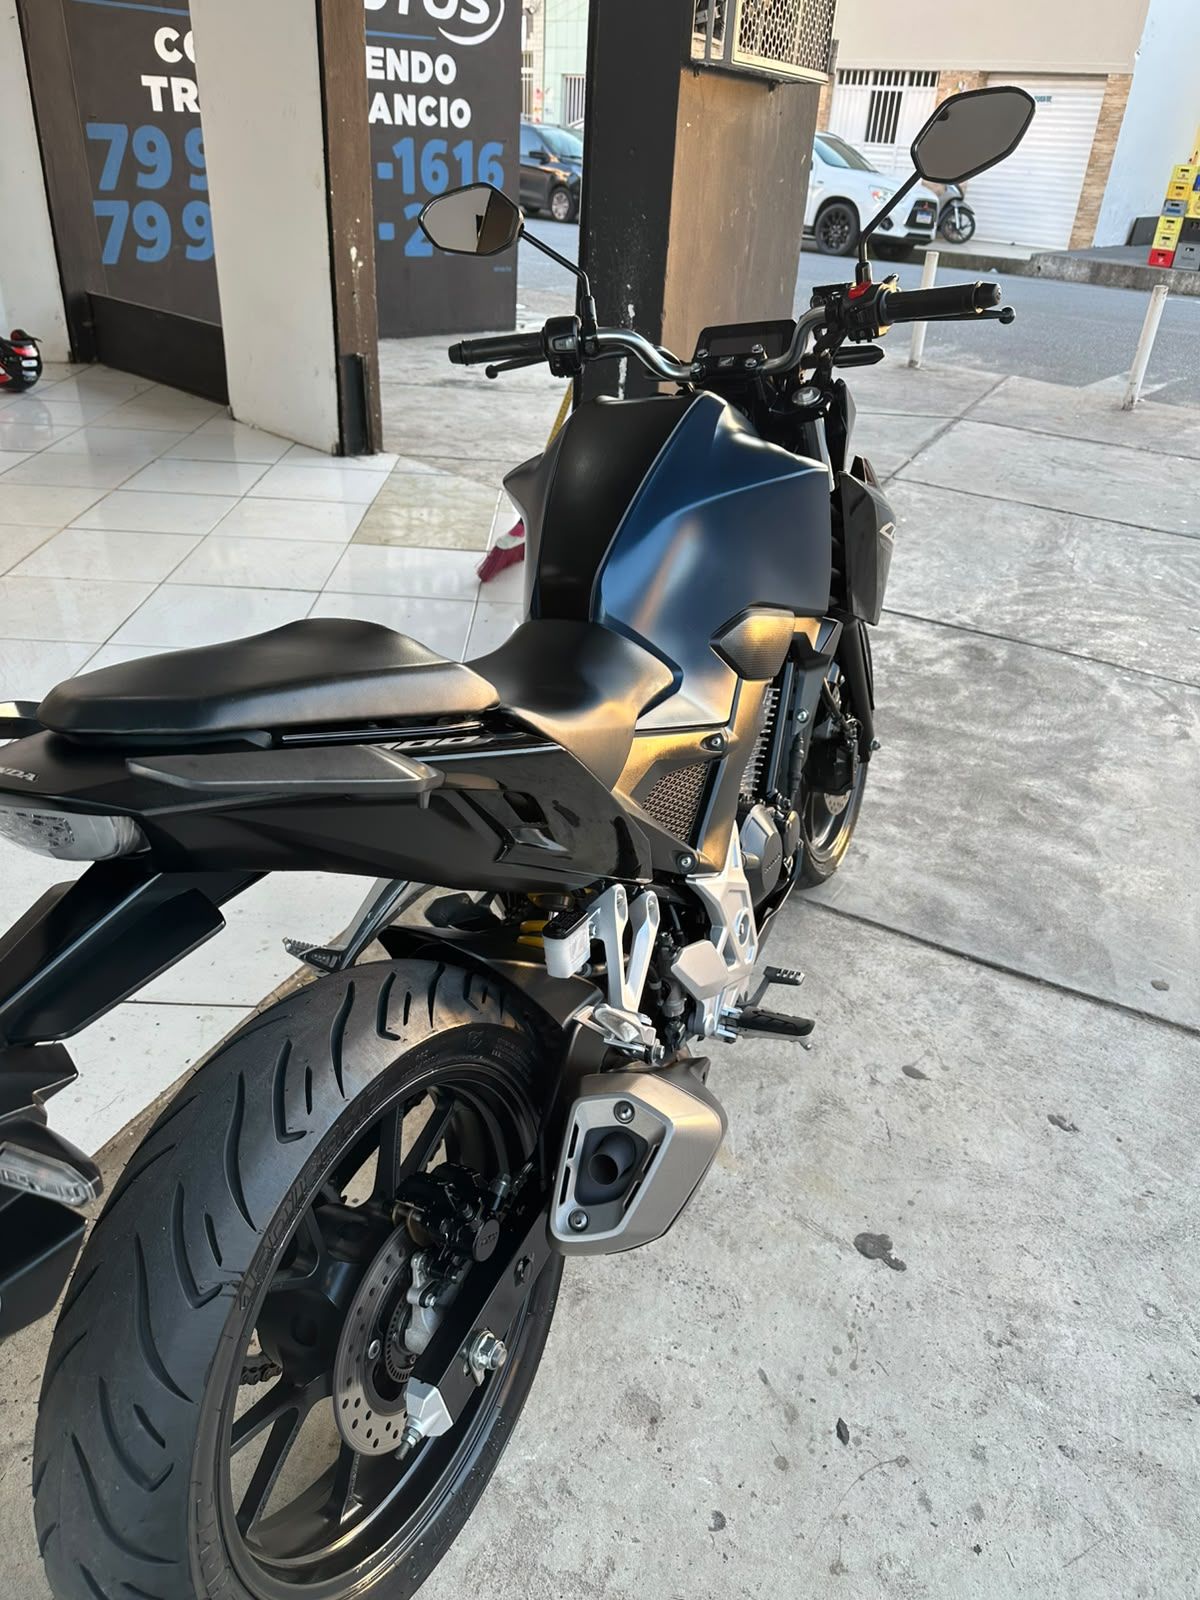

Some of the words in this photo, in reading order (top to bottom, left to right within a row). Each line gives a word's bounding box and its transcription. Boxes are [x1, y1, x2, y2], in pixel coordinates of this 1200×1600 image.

[365, 46, 457, 85] ENDO
[140, 74, 201, 113] TR
[368, 92, 472, 129] ANCIO
[85, 122, 173, 191] 79
[377, 136, 505, 195] -1616
[92, 200, 172, 265] 79
